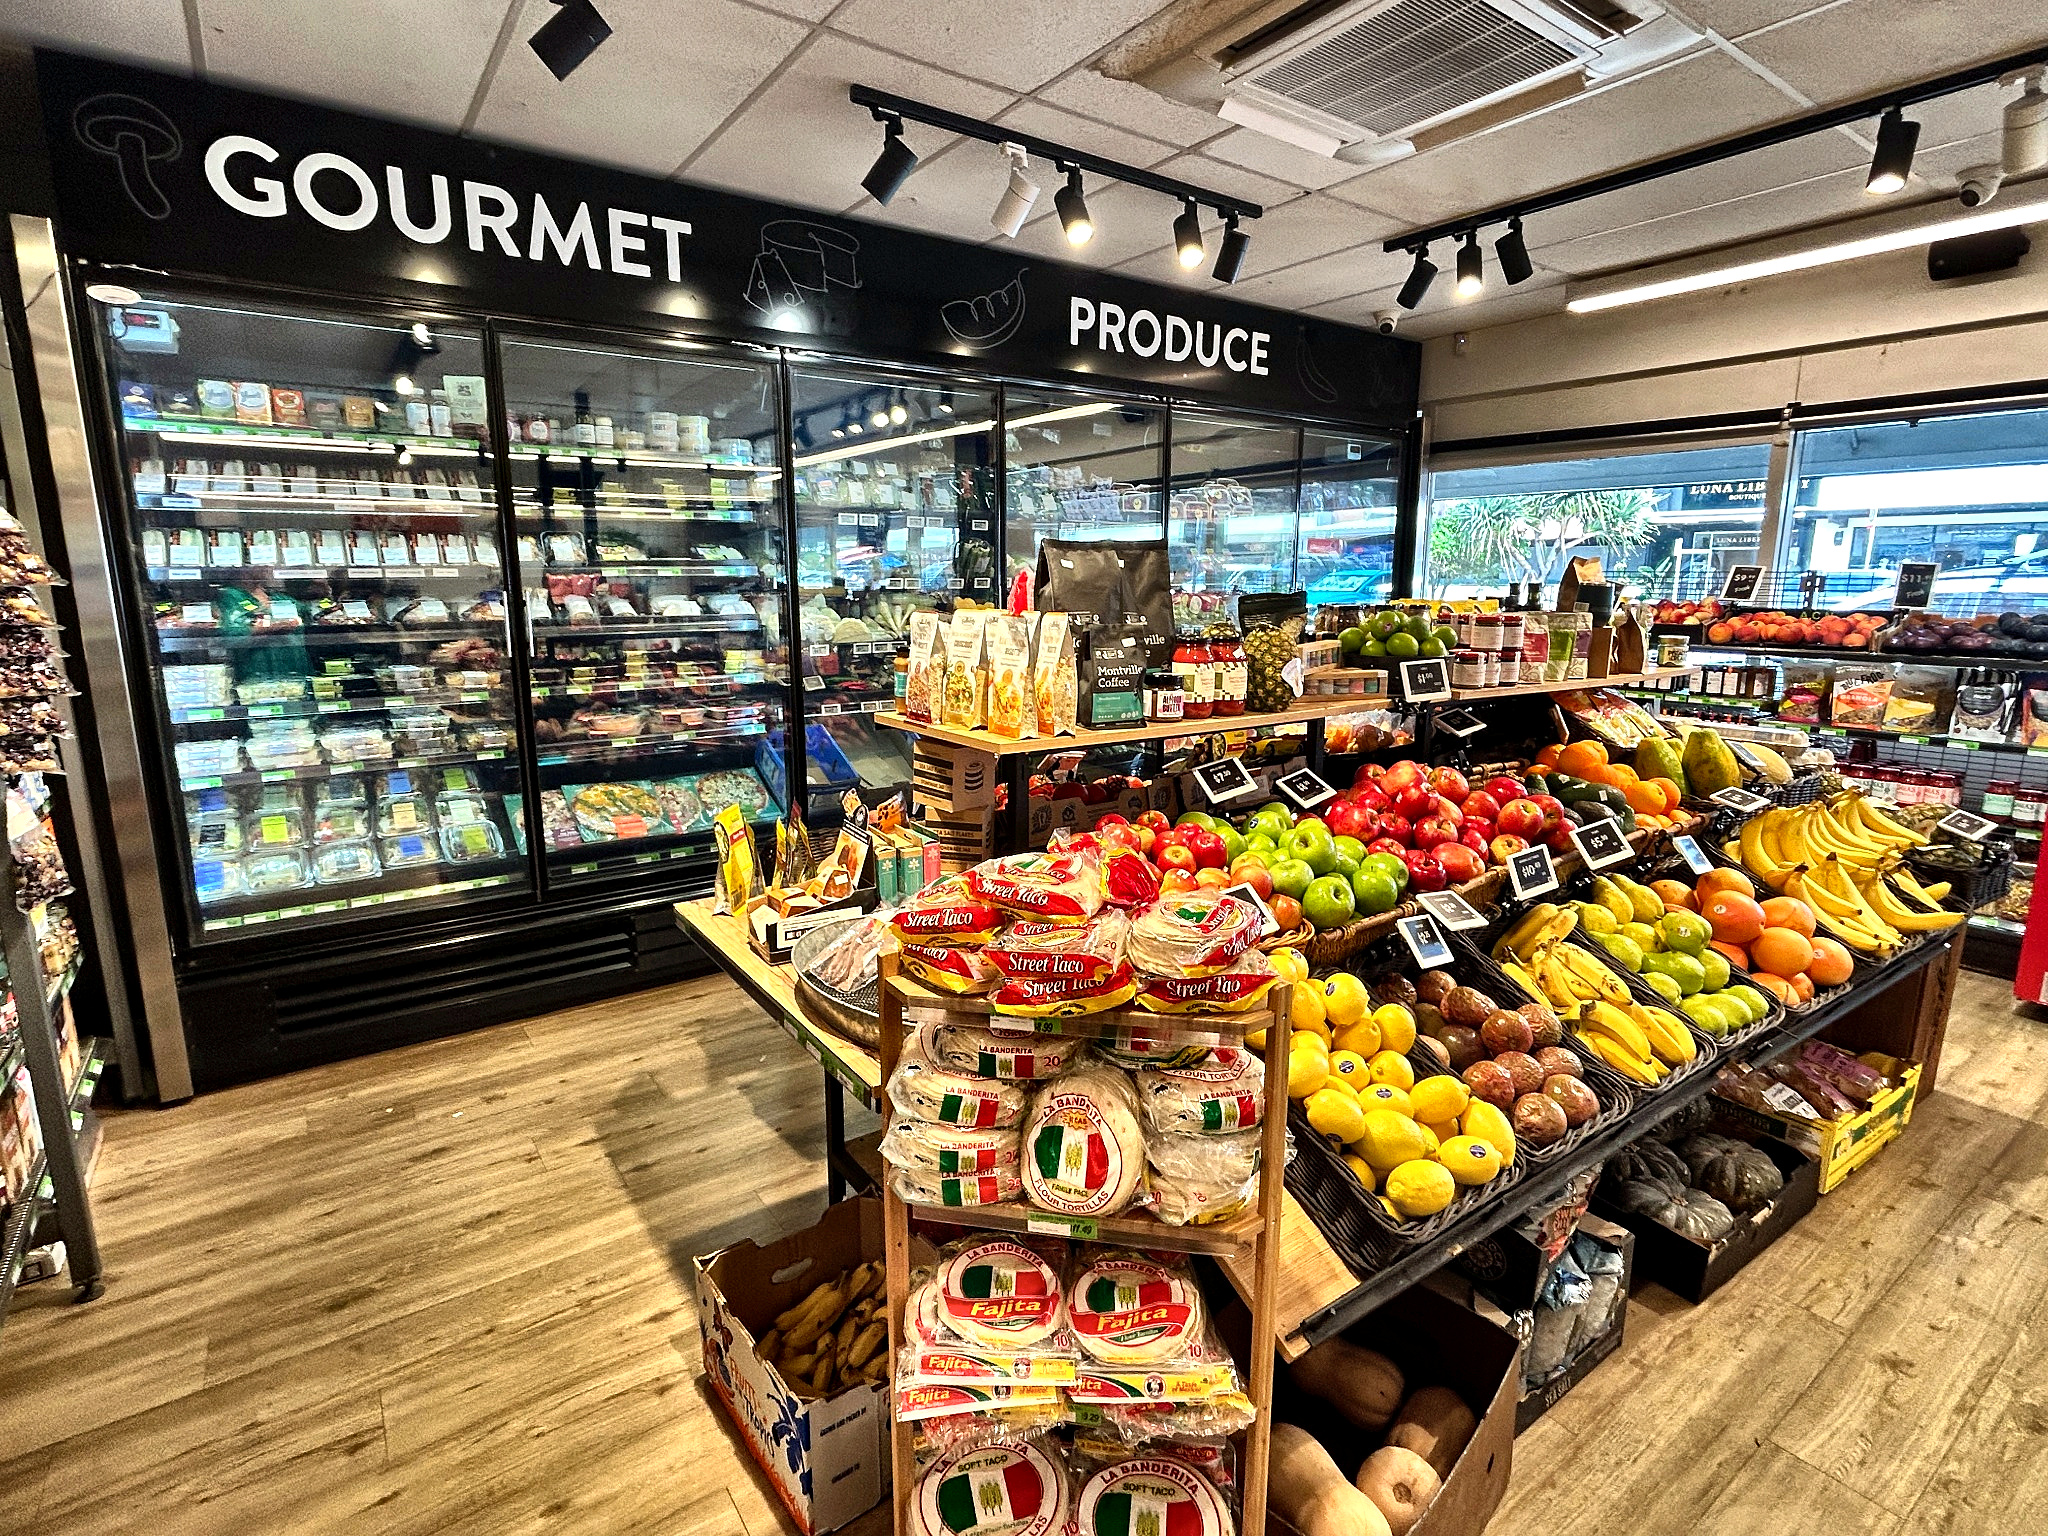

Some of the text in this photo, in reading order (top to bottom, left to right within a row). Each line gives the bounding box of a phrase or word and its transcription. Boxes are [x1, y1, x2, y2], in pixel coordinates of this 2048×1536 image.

[204, 135, 692, 283] GOURMET
[1070, 296, 1270, 376] PRODUCE
[1690, 483, 1733, 495] LUNA
[1097, 664, 1143, 676] Montville
[1097, 677, 1130, 688] Coffee
[977, 878, 1014, 898] Street
[1016, 886, 1049, 906] Taco
[904, 908, 973, 927] Street Taco
[1008, 952, 1084, 973] Street Taco
[978, 1045, 1033, 1055] LA BANDERITA
[1043, 1056, 1061, 1067] 20
[957, 1087, 1000, 1100] BANDERITA
[1199, 1089, 1252, 1100] LA BANDERITA
[1035, 1178, 1110, 1213] FLOUR TORTILLAS
[965, 1243, 1046, 1269] LA BANDERITA
[970, 1300, 1041, 1318] Fajita
[1097, 1306, 1168, 1332] Fajita
[1054, 1334, 1069, 1347] 10
[1187, 1343, 1202, 1357] 10
[928, 1356, 972, 1371] Fajita
[908, 1389, 950, 1405] Fajita
[935, 1459, 951, 1474] LA
[957, 1454, 1008, 1473] SOFT TACO
[1100, 1461, 1199, 1494] LA BANDERITA
[1122, 1482, 1176, 1497] SOFT TACO
[1060, 1520, 1080, 1536] 10
